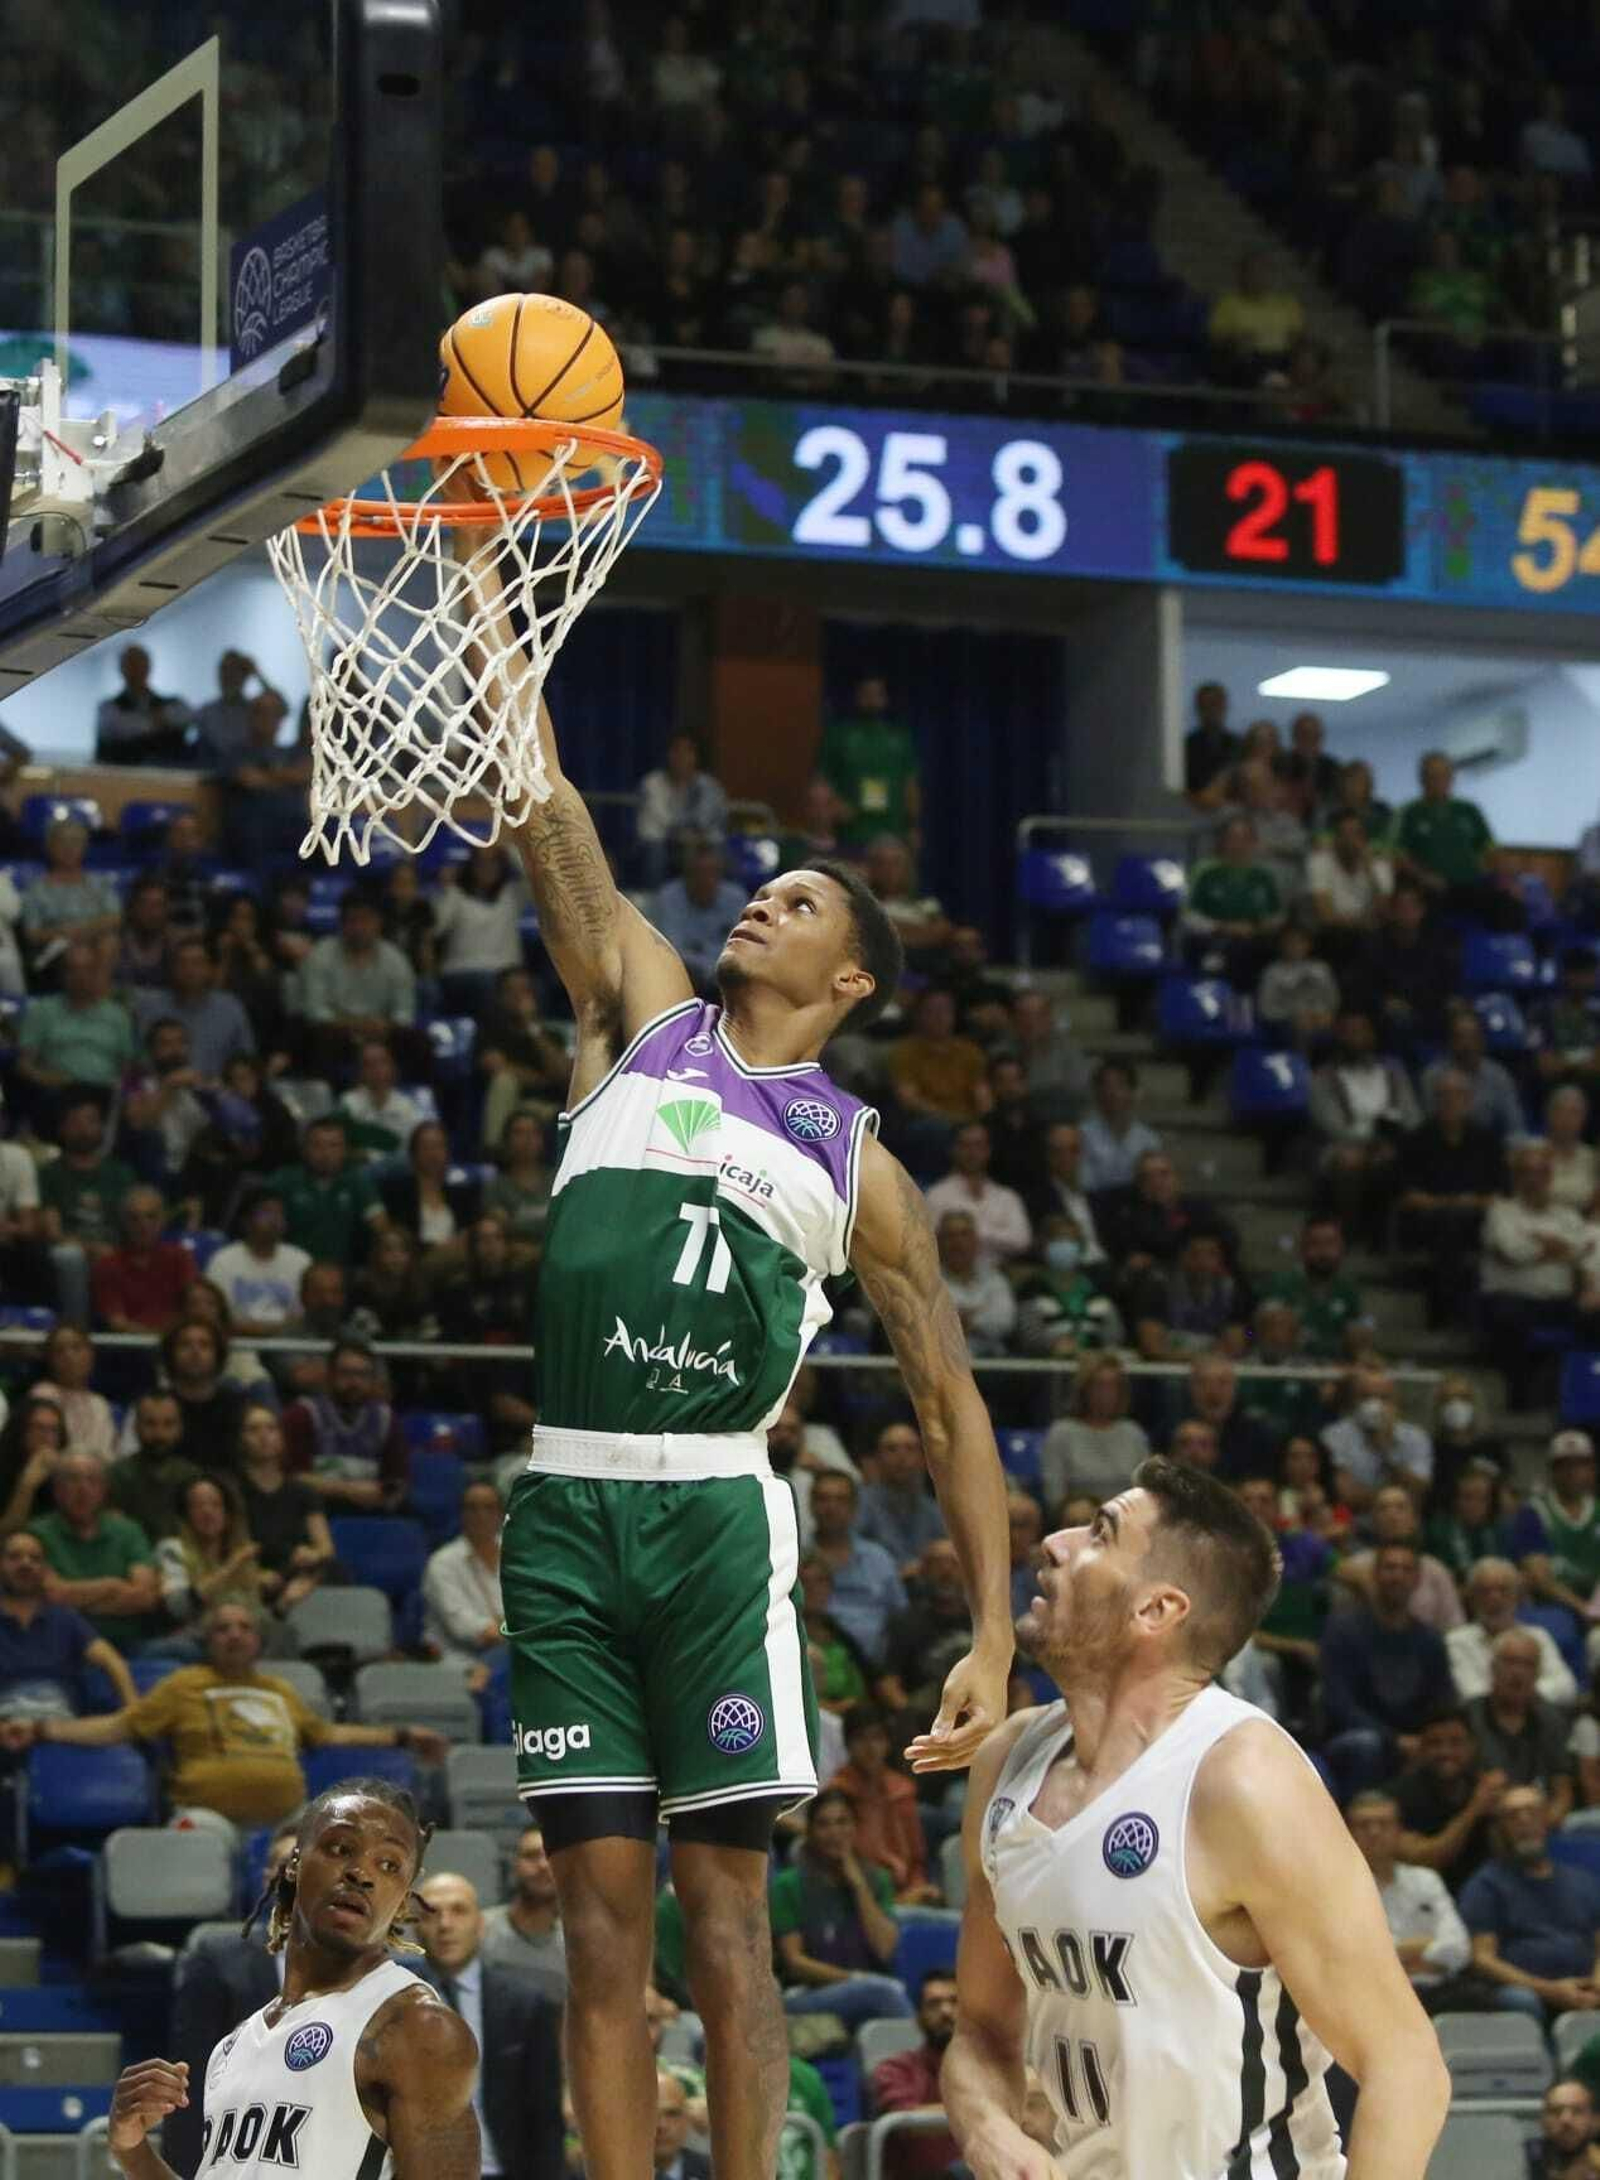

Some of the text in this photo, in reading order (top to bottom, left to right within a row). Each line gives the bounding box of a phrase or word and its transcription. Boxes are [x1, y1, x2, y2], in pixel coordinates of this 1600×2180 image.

[792, 425, 1067, 561] 25.8
[1225, 459, 1339, 567] 21
[603, 1315, 740, 1386] Andalucía
[1004, 1927, 1138, 2008] AOK
[1055, 2034, 1111, 2128] 11
